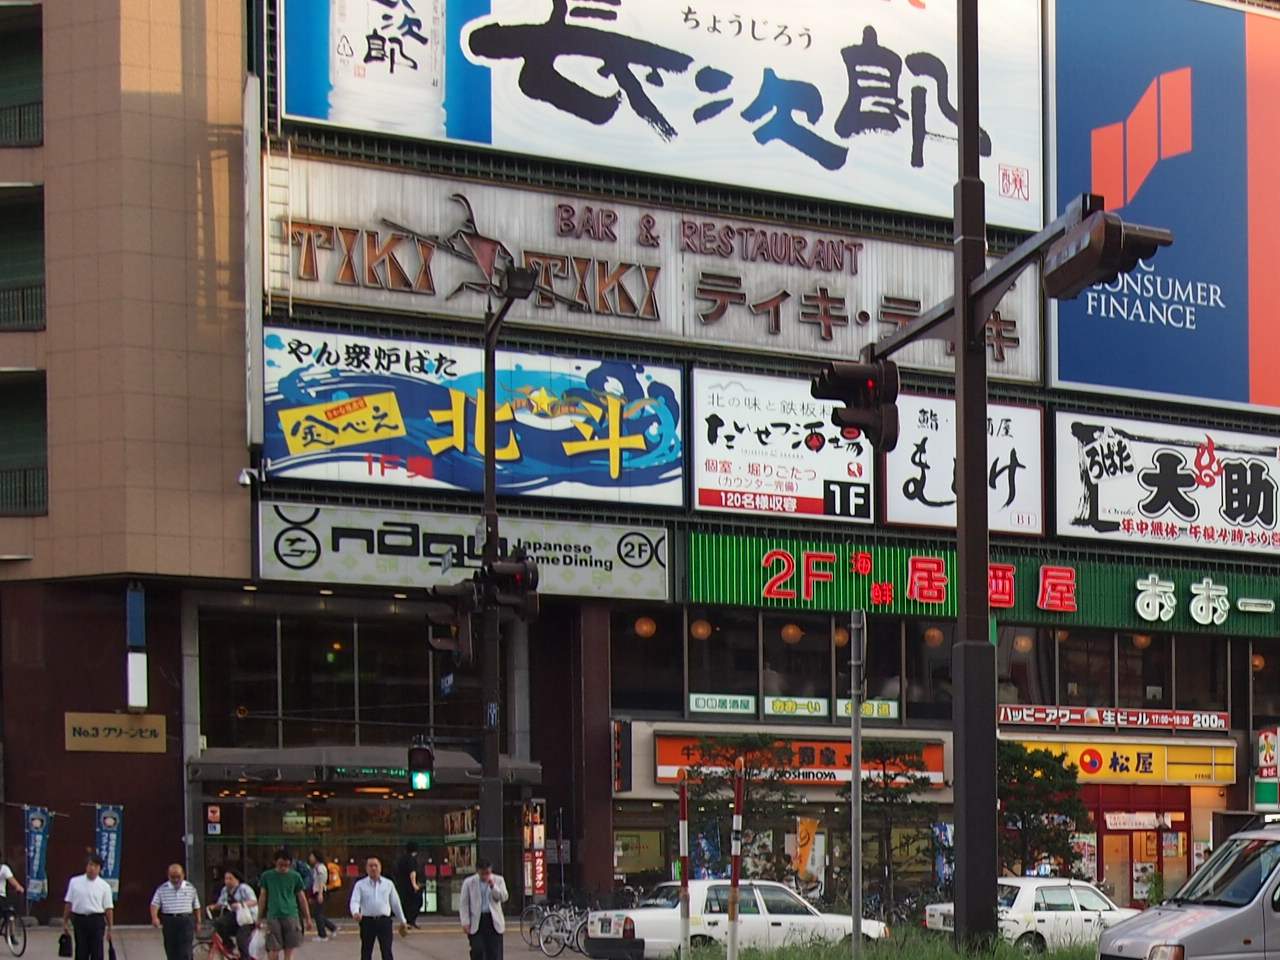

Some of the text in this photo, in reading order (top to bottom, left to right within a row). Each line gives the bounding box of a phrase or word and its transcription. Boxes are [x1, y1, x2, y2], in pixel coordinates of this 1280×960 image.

[682, 6, 814, 50] ちょうじろう
[556, 203, 864, 276] BAR & RESTAURANT
[281, 221, 662, 321] TIKI TIKI
[1093, 272, 1226, 308] ONSUMER
[1086, 292, 1197, 329] FINANCE
[287, 337, 458, 378] やん衆炉ばた
[426, 387, 646, 481] 北斗
[1086, 438, 1135, 482] ろばた
[719, 492, 798, 512] 120名様収容
[829, 484, 866, 516] 1F
[1137, 449, 1279, 531] 大助
[515, 538, 592, 554] Japanese
[527, 553, 614, 572] ome Dining
[624, 541, 648, 558] 2F
[761, 550, 837, 601] 2F
[71, 726, 99, 738] No.3
[999, 706, 1081, 723] ハッピーアワー
[1102, 709, 1150, 726] 生ビール
[1109, 751, 1154, 774] 松屋
